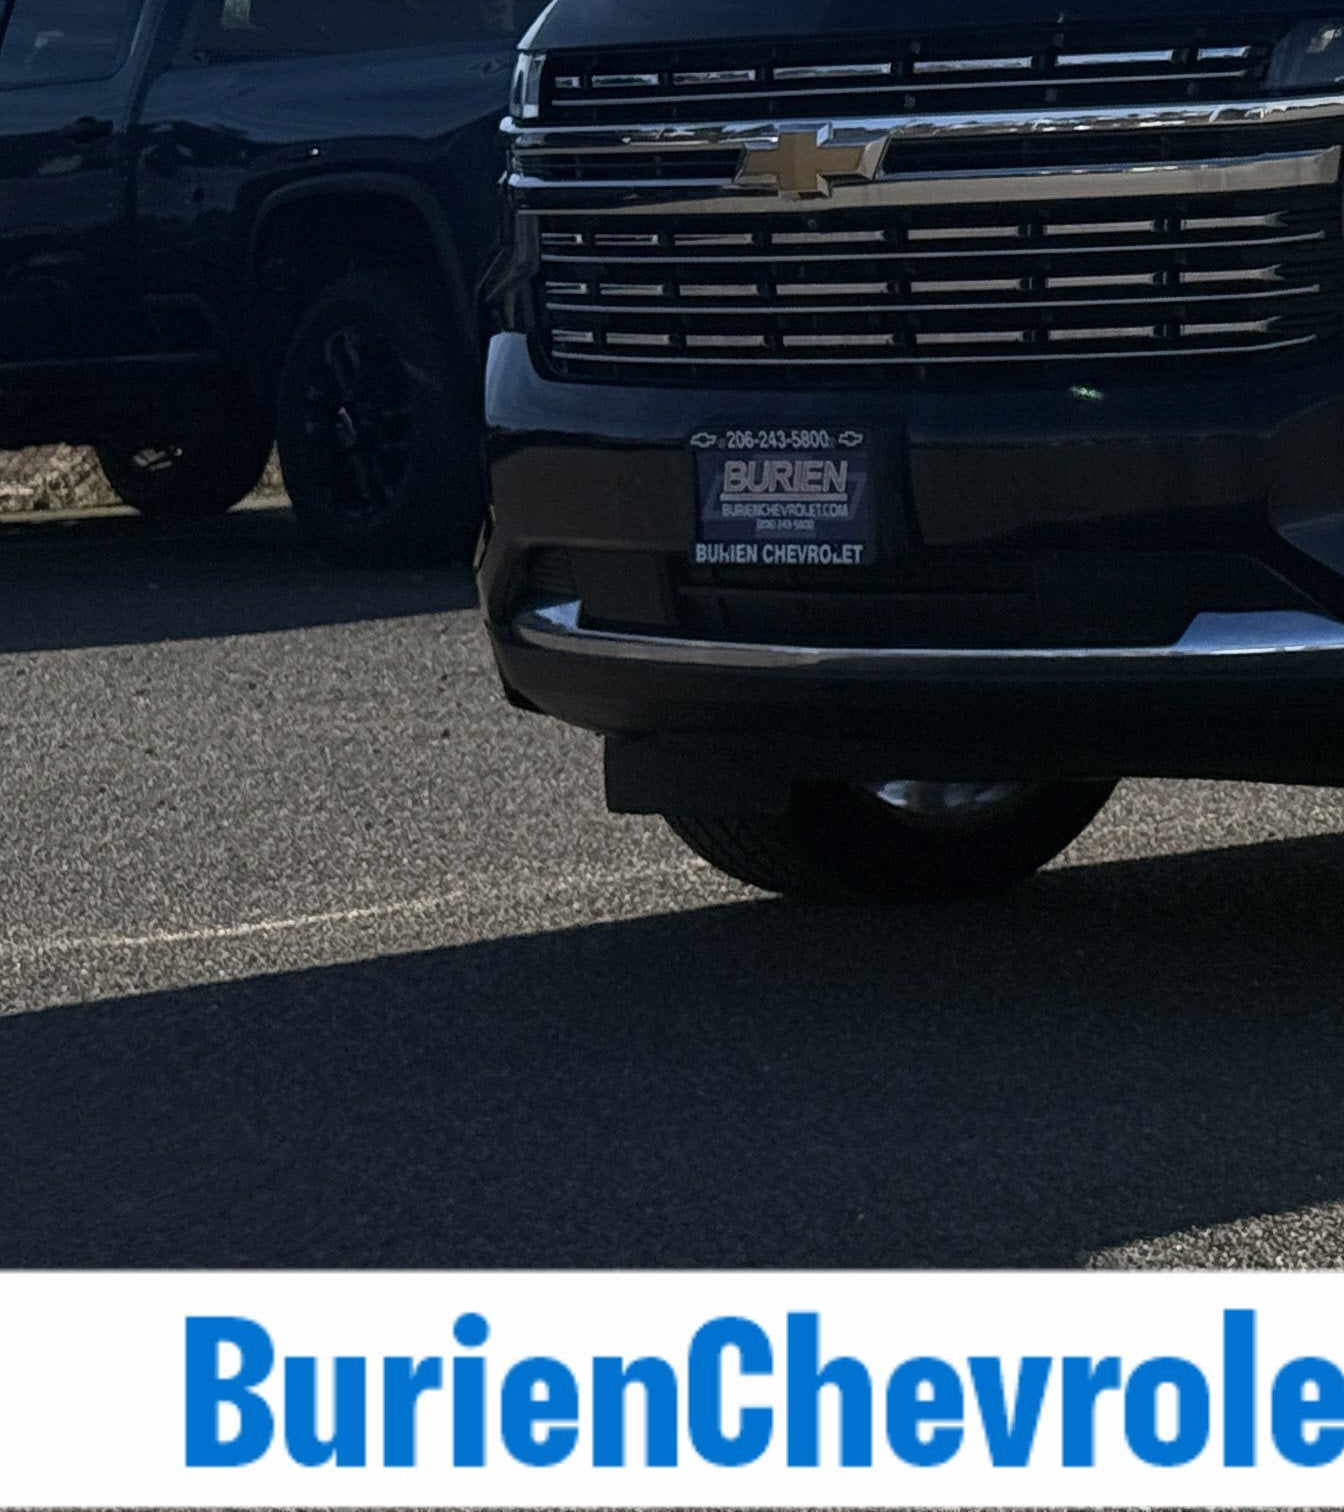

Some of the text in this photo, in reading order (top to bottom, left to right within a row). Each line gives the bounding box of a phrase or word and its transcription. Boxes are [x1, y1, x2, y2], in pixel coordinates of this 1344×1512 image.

[726, 430, 829, 449] 206-243-5800
[723, 460, 848, 492] BURIEN
[721, 502, 849, 518] BURIENCHEVROLET.COM
[695, 543, 863, 564] BURIEN CHEVROLET
